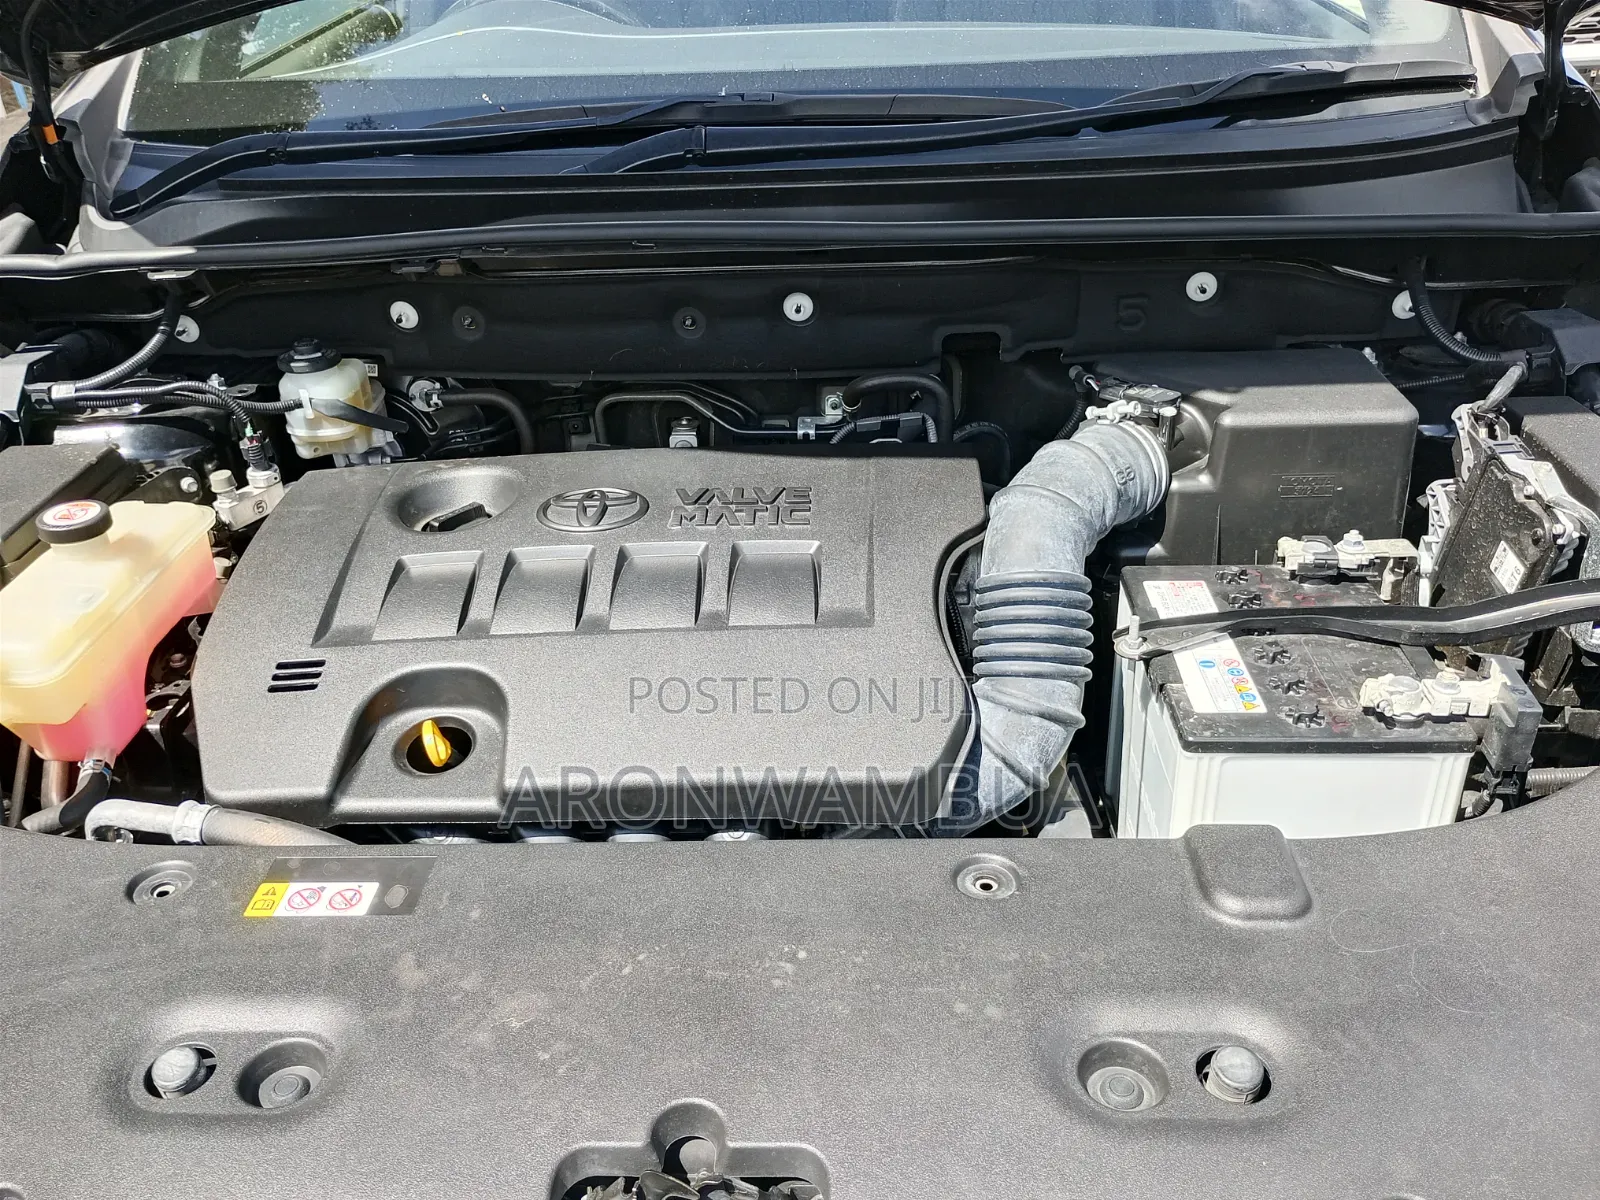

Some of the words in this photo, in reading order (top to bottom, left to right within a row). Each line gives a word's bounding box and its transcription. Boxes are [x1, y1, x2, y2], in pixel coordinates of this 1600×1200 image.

[675, 486, 812, 506] VALVE
[255, 501, 266, 514] 5
[668, 505, 812, 528] MATIC
